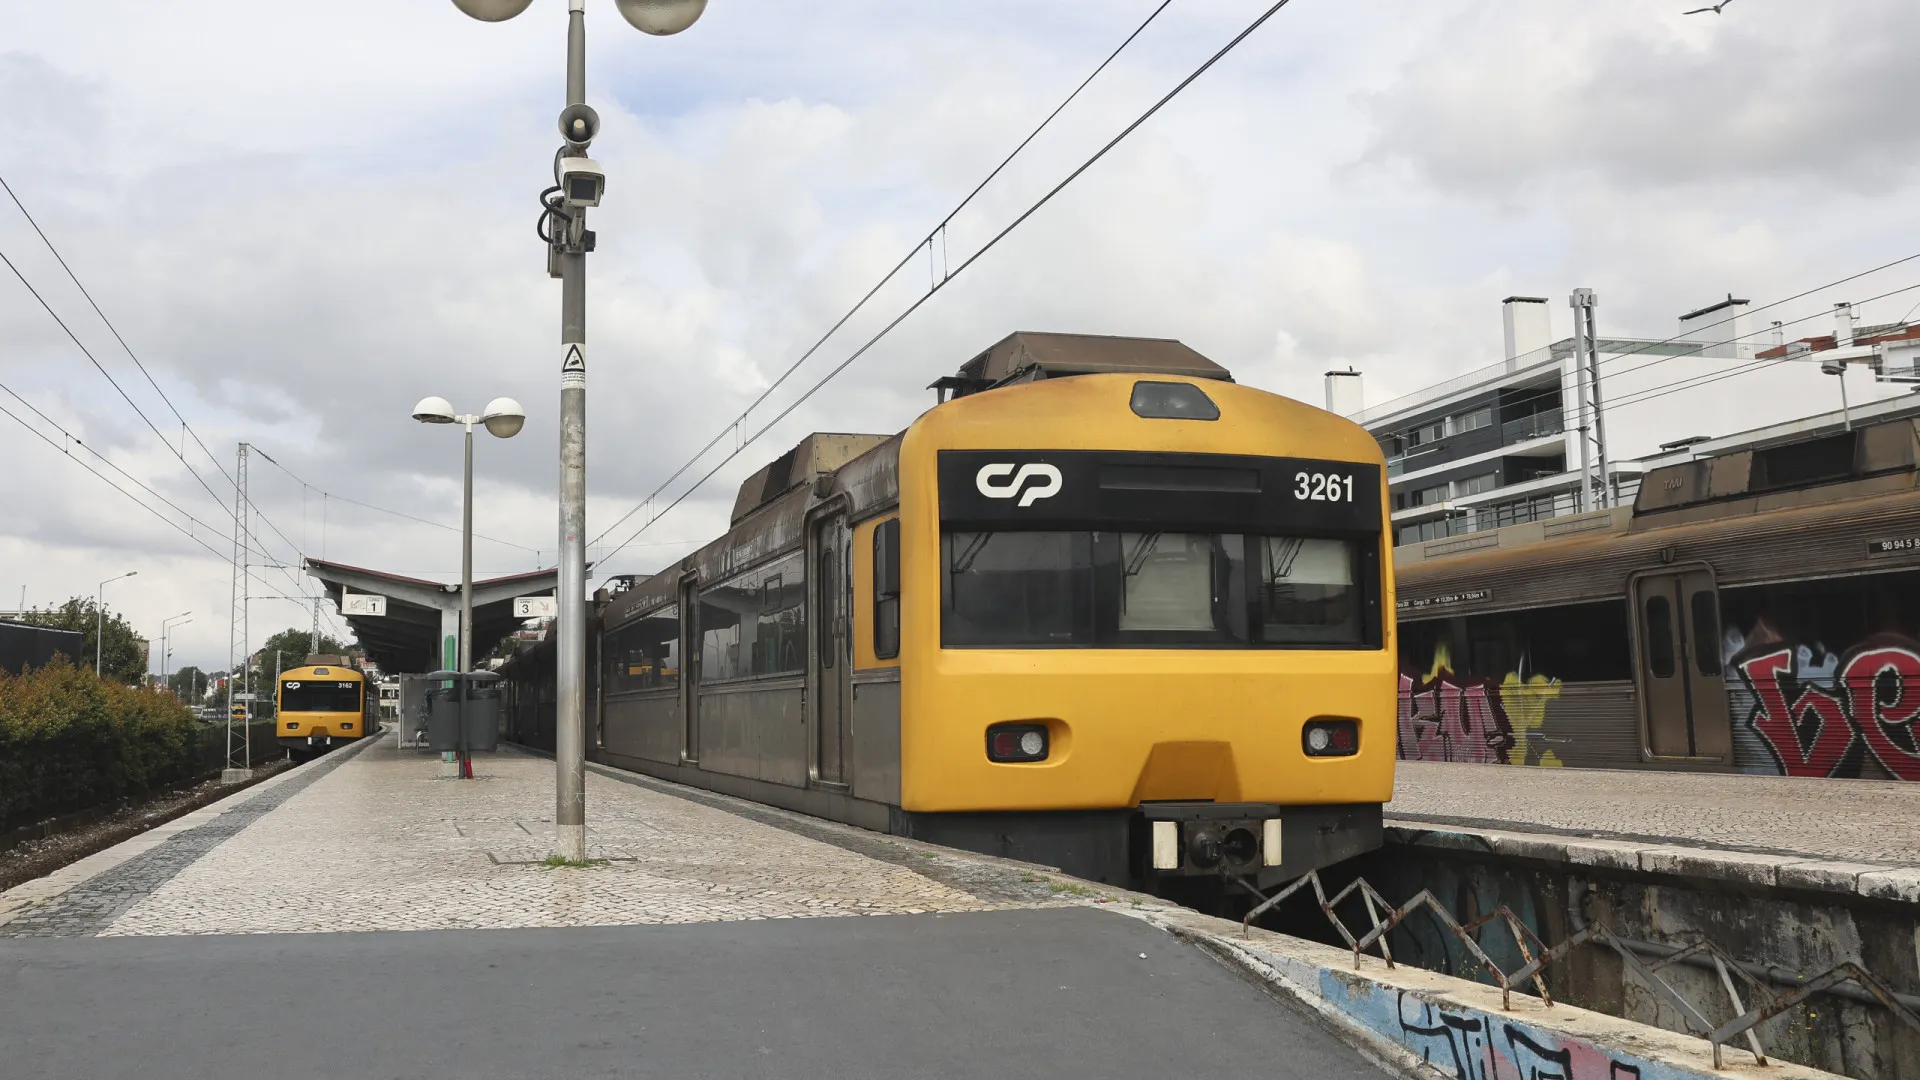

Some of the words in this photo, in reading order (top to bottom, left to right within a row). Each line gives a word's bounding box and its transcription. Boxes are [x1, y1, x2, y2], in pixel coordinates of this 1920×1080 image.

[976, 463, 1063, 507] CP
[1293, 472, 1354, 503] 3261
[1882, 541, 1893, 550] 90
[1894, 540, 1904, 549] 94
[1906, 539, 1912, 548] 5
[371, 602, 376, 612] 1
[522, 604, 529, 613] 3
